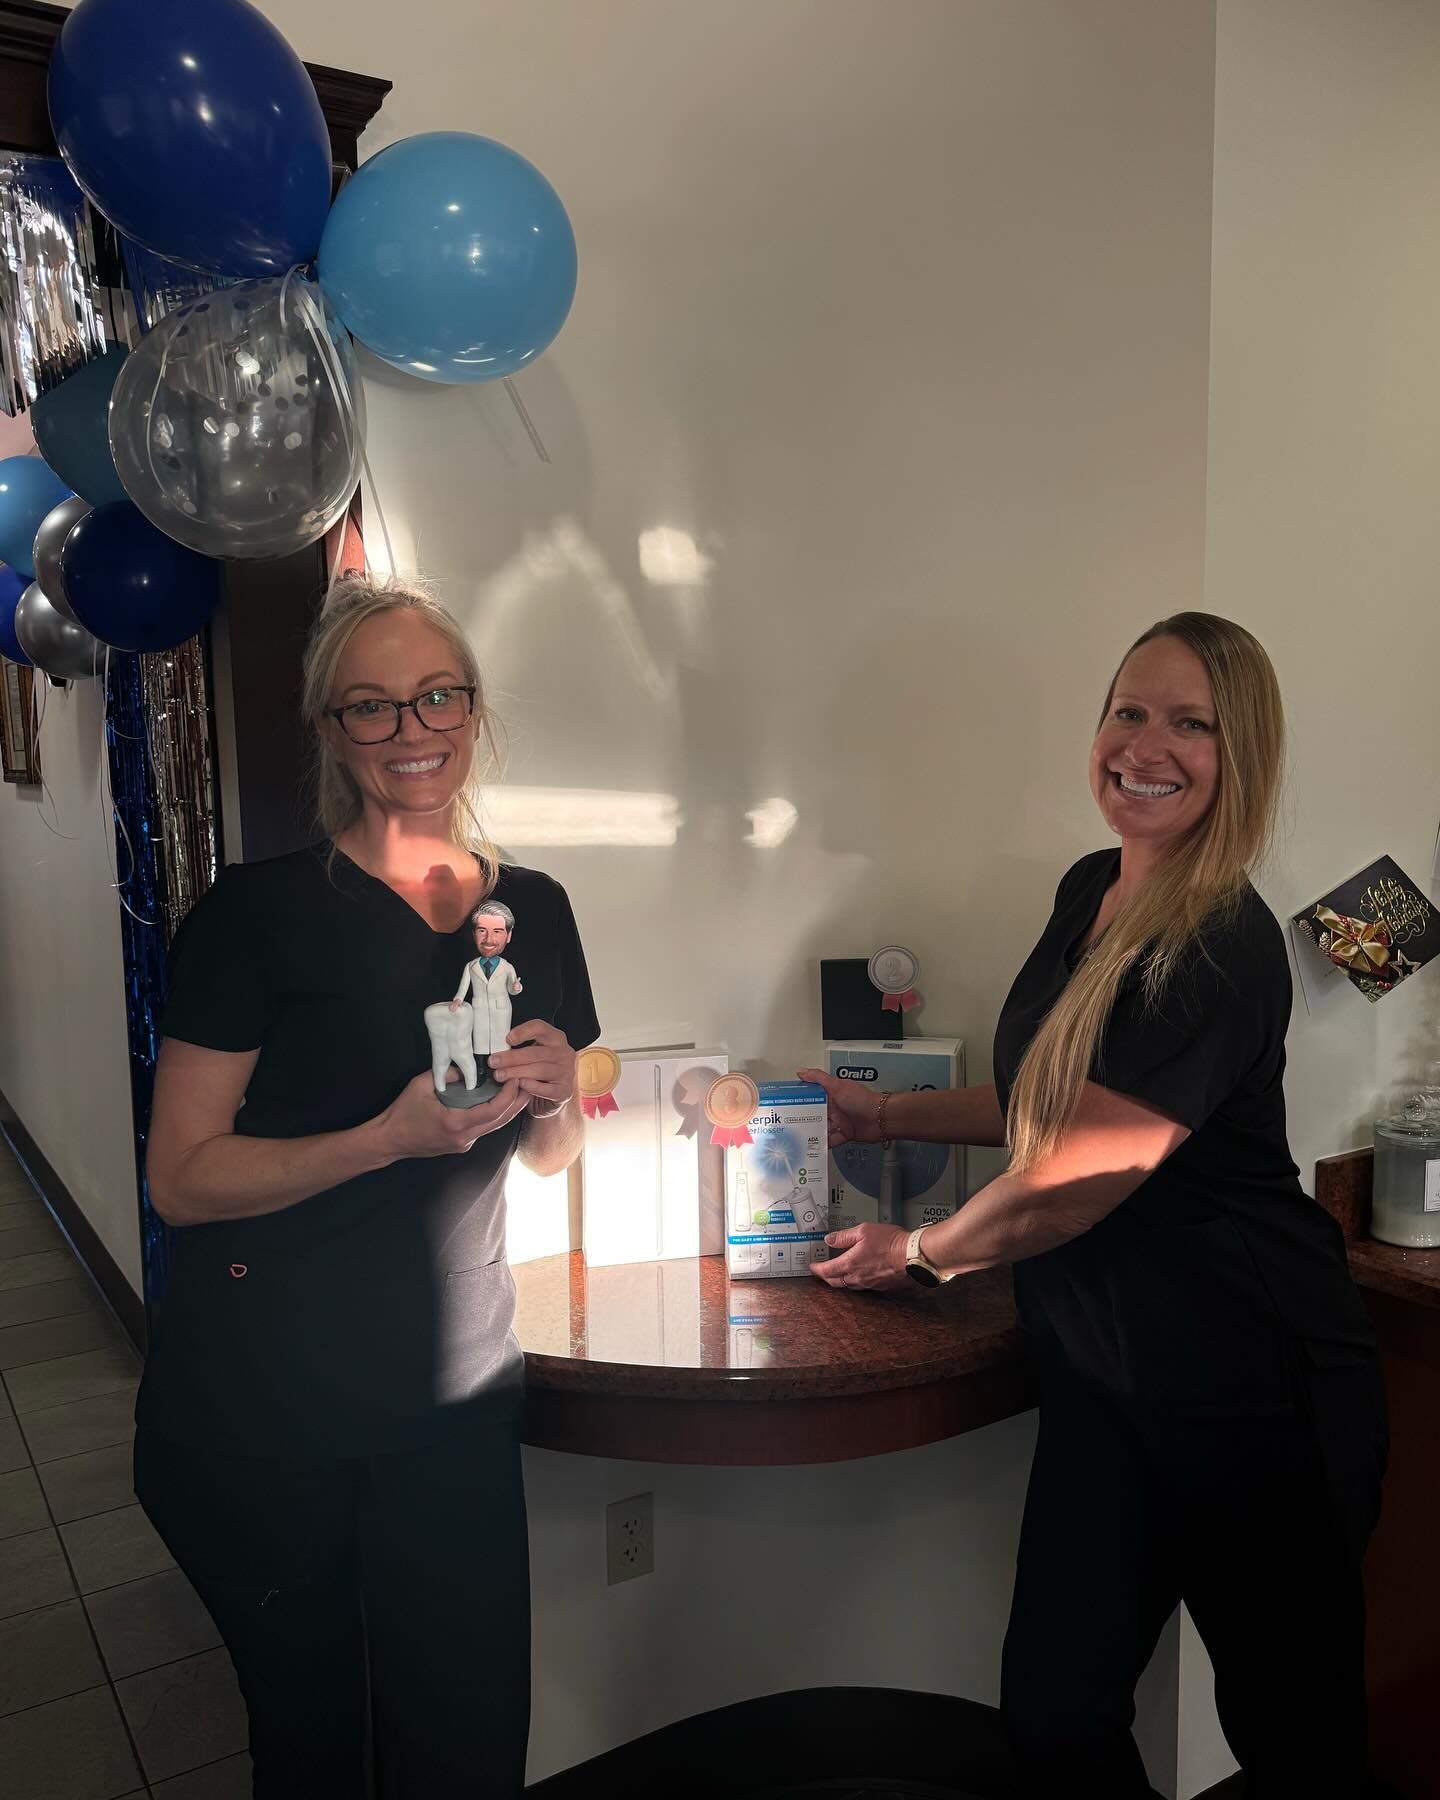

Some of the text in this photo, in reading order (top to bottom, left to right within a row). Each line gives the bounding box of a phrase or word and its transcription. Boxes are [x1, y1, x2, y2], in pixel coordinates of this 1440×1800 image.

[583, 1057, 600, 1084] 1
[839, 1067, 876, 1080] Oral-B
[923, 1207, 952, 1217] 400%
[922, 1217, 949, 1225] MOR
